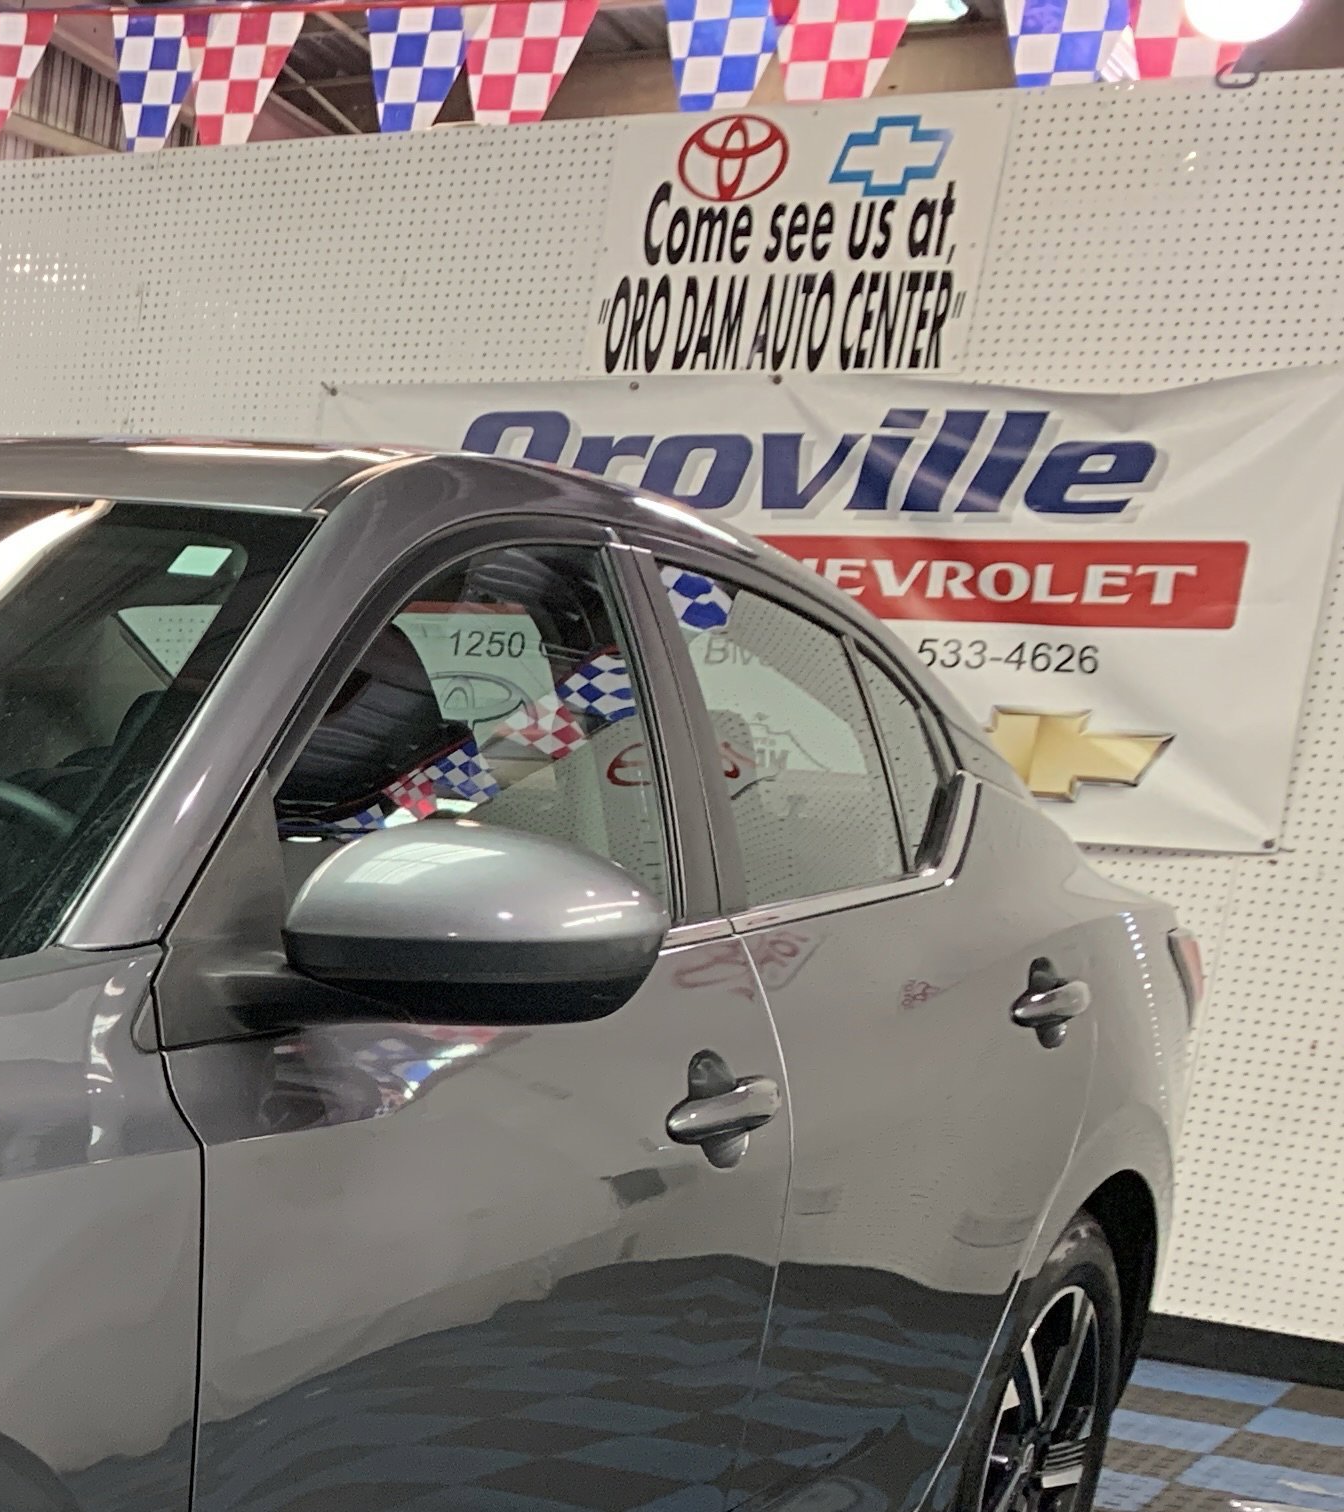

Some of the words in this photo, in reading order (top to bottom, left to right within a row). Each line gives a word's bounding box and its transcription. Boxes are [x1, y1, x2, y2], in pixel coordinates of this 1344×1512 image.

[643, 181, 753, 267] Come
[764, 201, 836, 262] see
[848, 197, 896, 260] us
[908, 181, 957, 264] at,
[597, 274, 672, 374] "ORO
[671, 274, 751, 373] DAM
[746, 271, 836, 373] AUTO
[839, 269, 968, 373] CENTER"
[800, 557, 1199, 606] EVROLET
[448, 628, 526, 659] 1250
